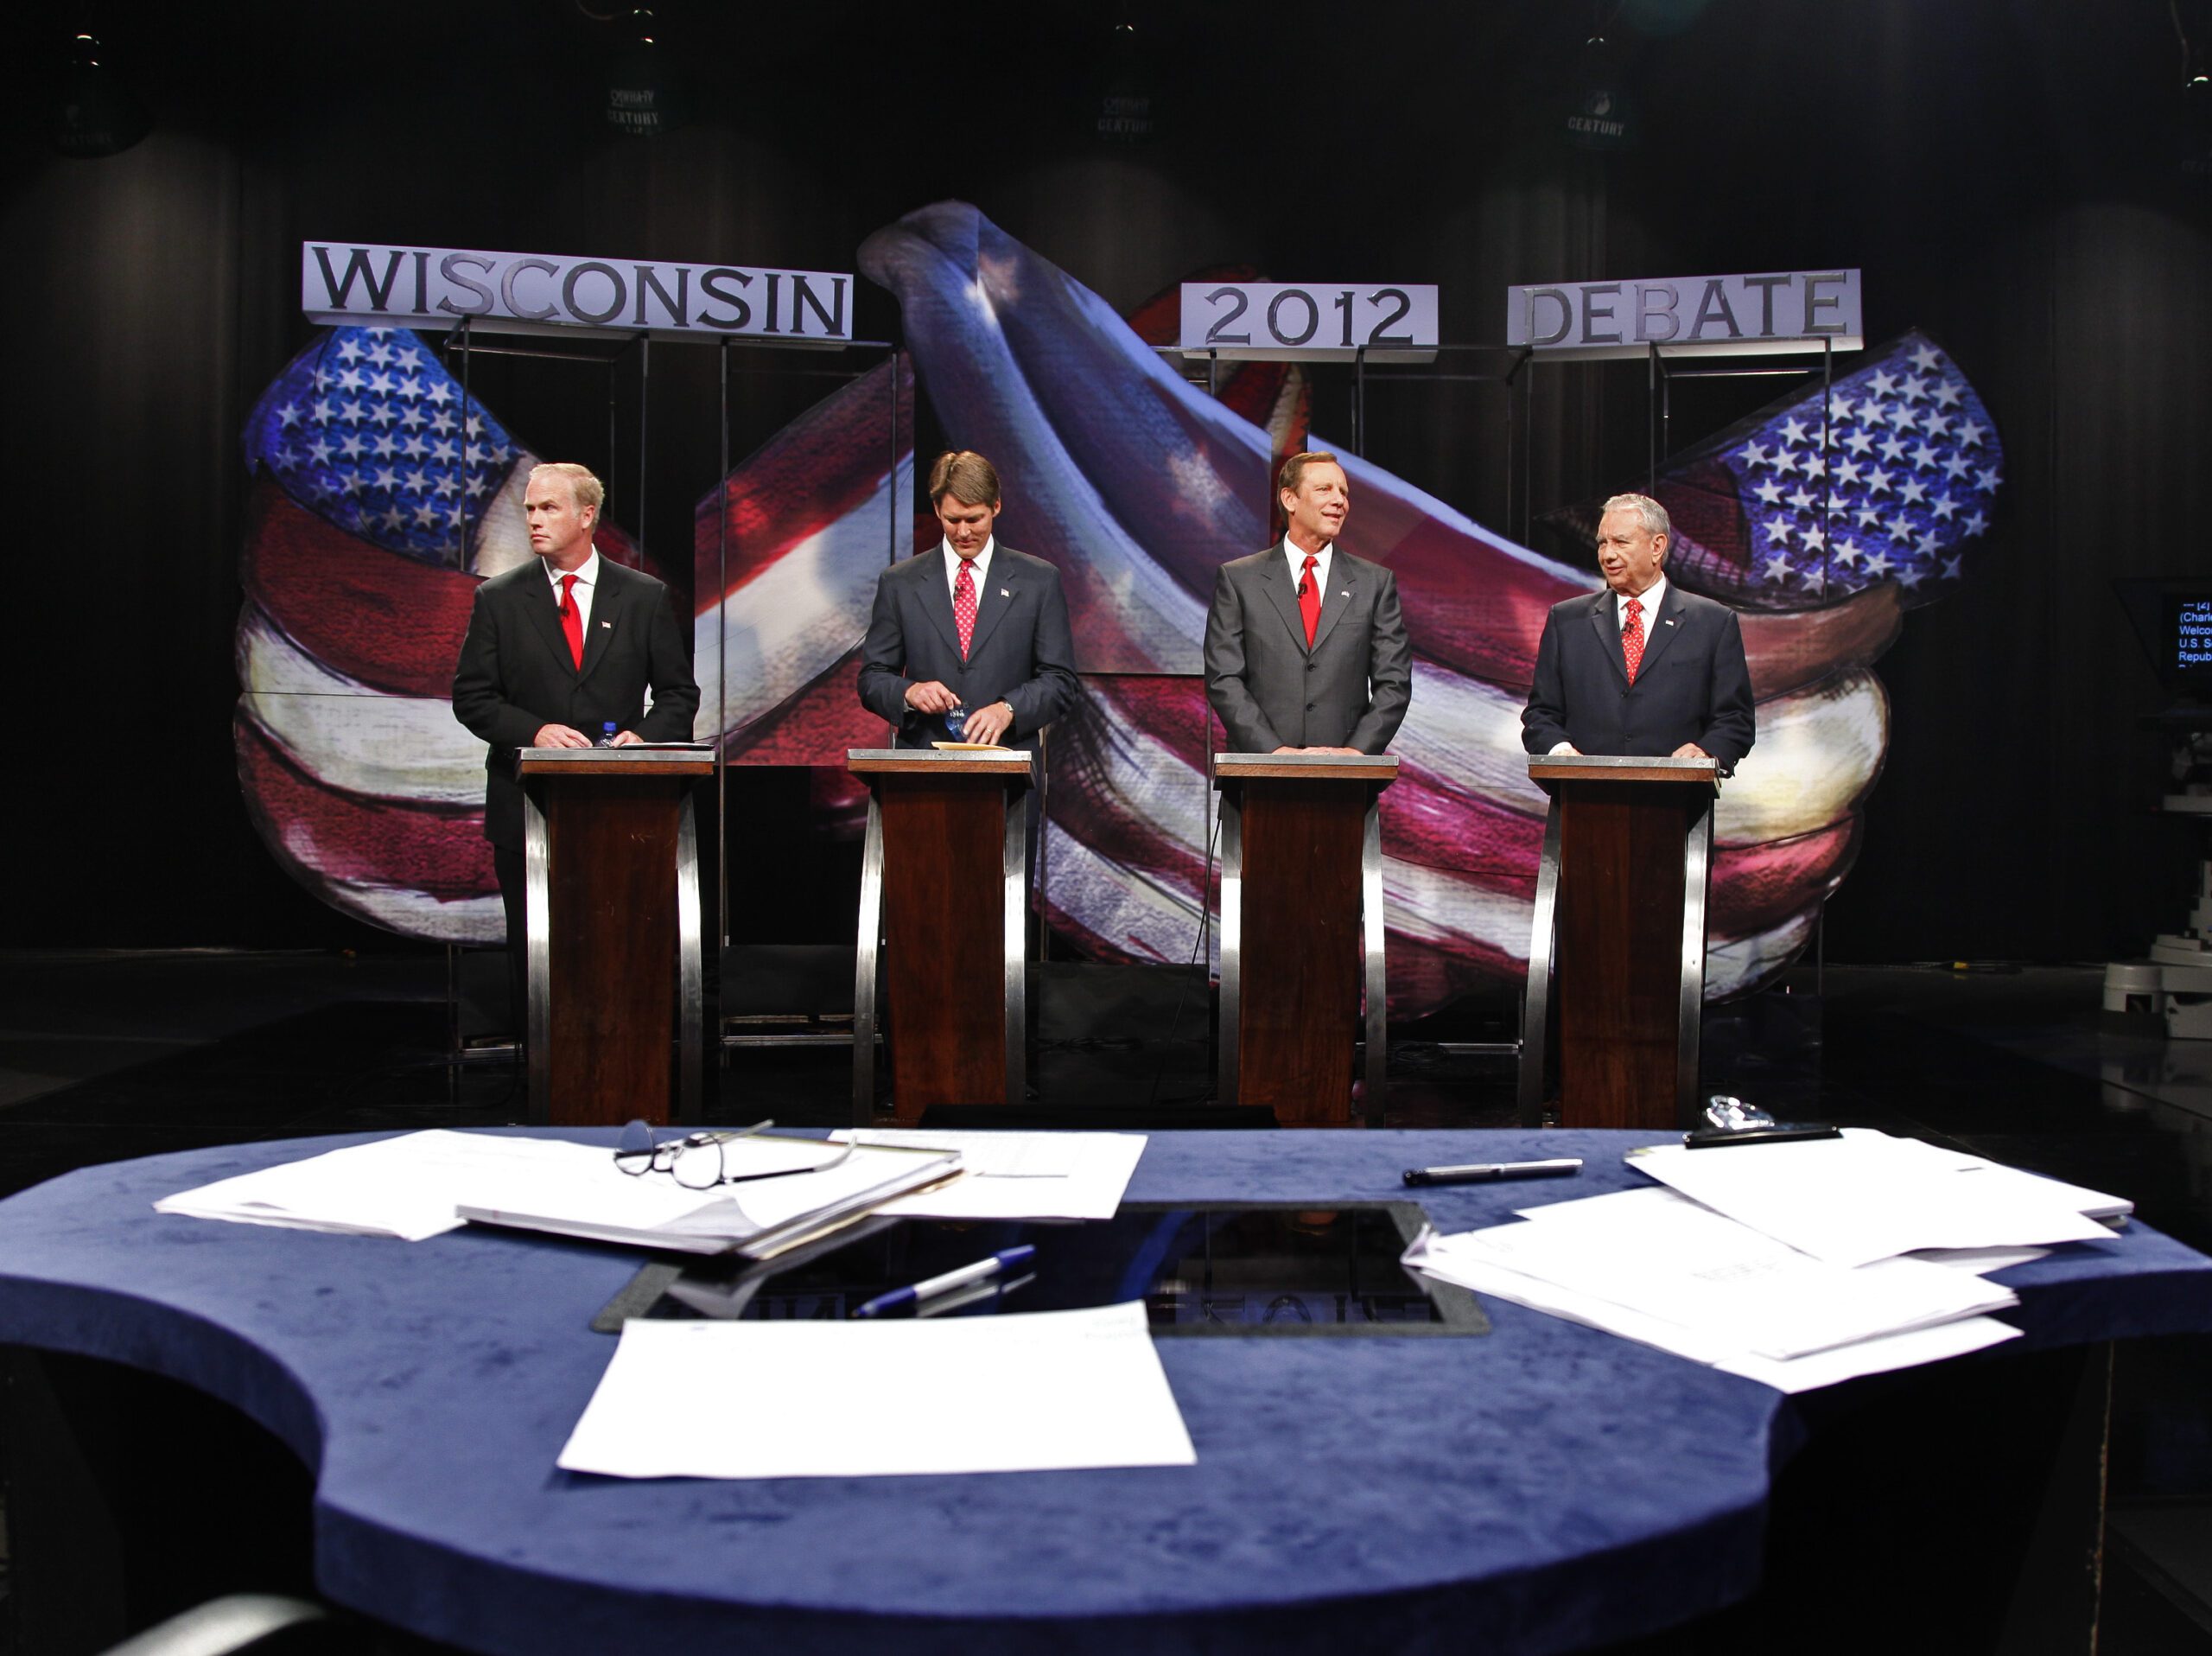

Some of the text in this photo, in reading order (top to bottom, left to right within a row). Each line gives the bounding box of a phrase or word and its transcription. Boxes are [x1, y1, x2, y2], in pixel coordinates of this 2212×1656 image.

[1567, 116, 1624, 137] CENTURY
[311, 245, 847, 336] WISCONSIN
[1524, 271, 1847, 346] DEBATE
[1204, 286, 1414, 347] 2012
[2179, 625, 2212, 635] Welco
[2179, 638, 2201, 648] U.S.
